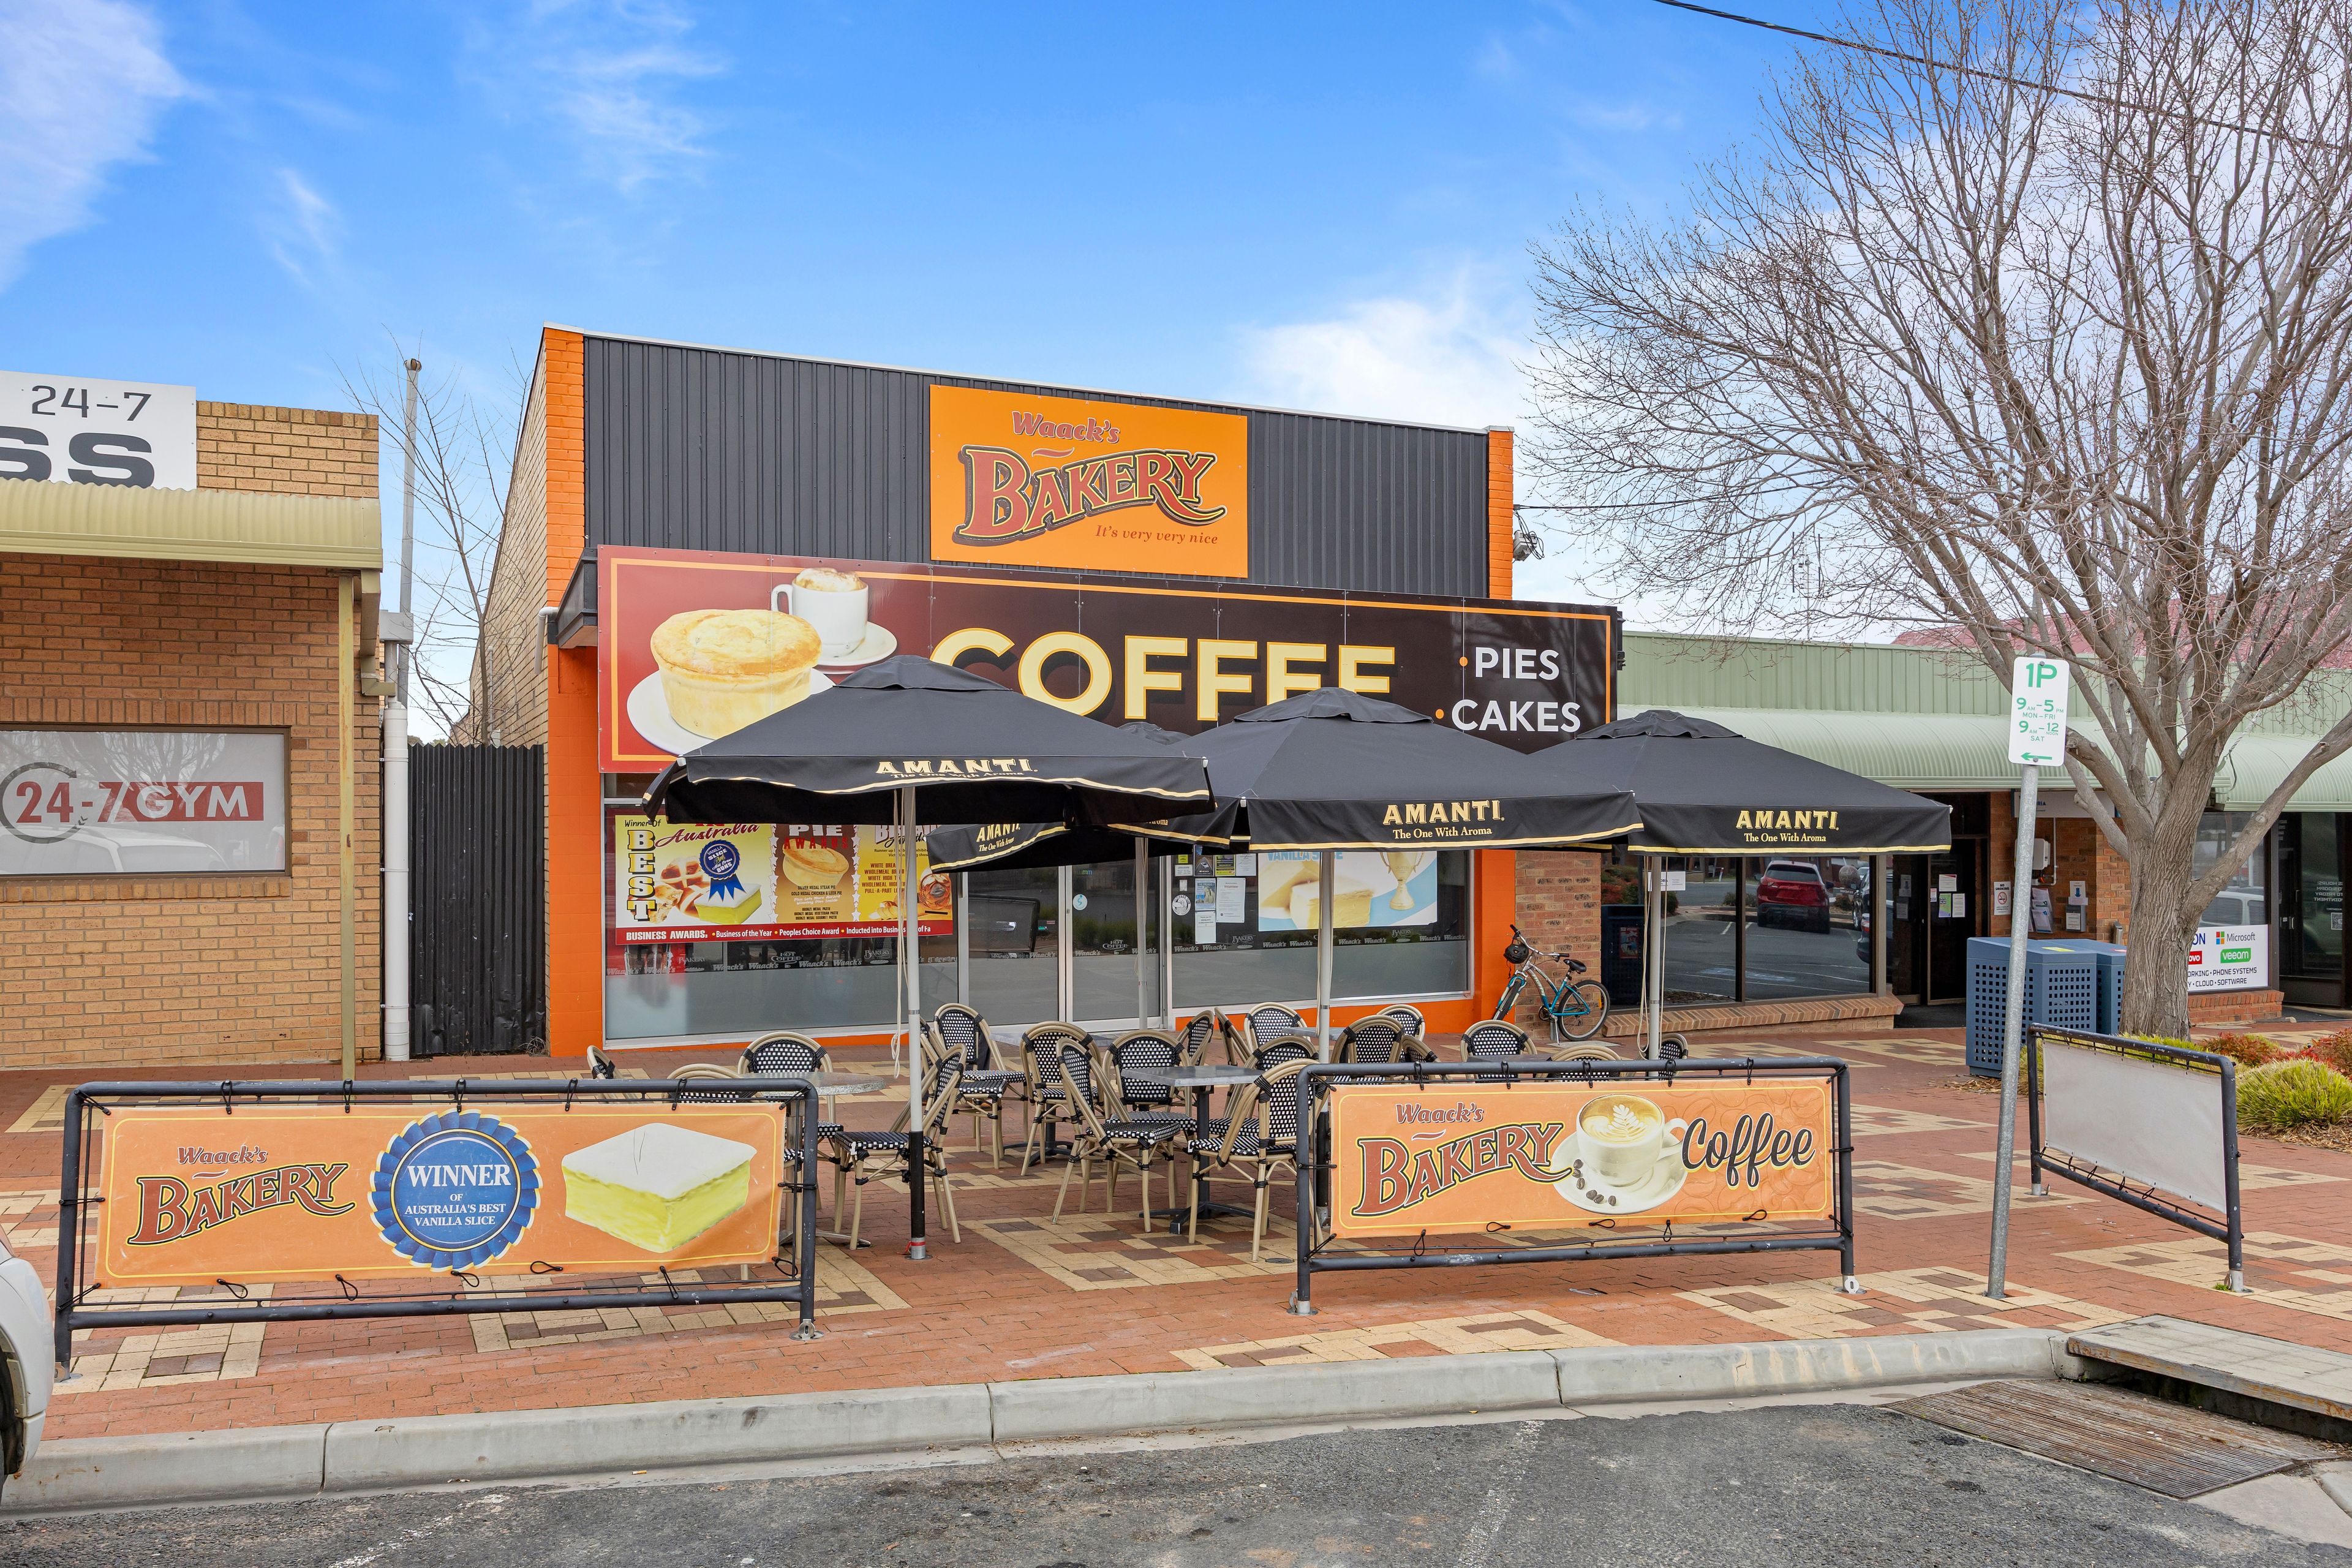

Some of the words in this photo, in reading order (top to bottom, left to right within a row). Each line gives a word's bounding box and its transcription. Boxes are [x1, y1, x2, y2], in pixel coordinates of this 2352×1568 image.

[31, 385, 152, 421] 24-7
[1011, 411, 1120, 443] Waack's
[954, 445, 1227, 546] BAKERY
[1096, 525, 1118, 538] It's
[1123, 529, 1152, 544] very
[1156, 531, 1186, 545] very
[1190, 532, 1218, 545] nice
[1474, 647, 1560, 680] PIES
[2026, 663, 2057, 688] 1P
[1452, 699, 1581, 733] CAKES
[875, 759, 1033, 774] AMANTI
[1382, 801, 1501, 826] AMANTI
[1736, 810, 1838, 829] AMANTI
[654, 823, 760, 848] Australia
[1393, 829, 1411, 839] The
[1413, 828, 1433, 838] One
[1435, 827, 1458, 837] With
[1461, 826, 1493, 837] Aroma
[1744, 833, 1759, 842] The
[1761, 833, 1778, 842] One
[1780, 833, 1799, 842] With
[1801, 833, 1826, 842] Aroma
[708, 848, 728, 861] SLICE
[626, 931, 666, 941] BUSINESS
[779, 929, 801, 937] Peoples
[2227, 932, 2255, 942] Microsoft
[2223, 951, 2249, 960] veeam
[1395, 1102, 1485, 1125] Waack's
[178, 1145, 268, 1164] Waack's
[1681, 1112, 1815, 1191] Coffee
[407, 1164, 511, 1187] WINNER
[1351, 1121, 1574, 1218] BAKERY
[126, 1163, 356, 1247] BAKERY
[404, 1204, 476, 1215] AUSTRALIA'S
[479, 1204, 506, 1213] BEST
[415, 1216, 462, 1226] VANILLA
[464, 1216, 496, 1225] SLICE
